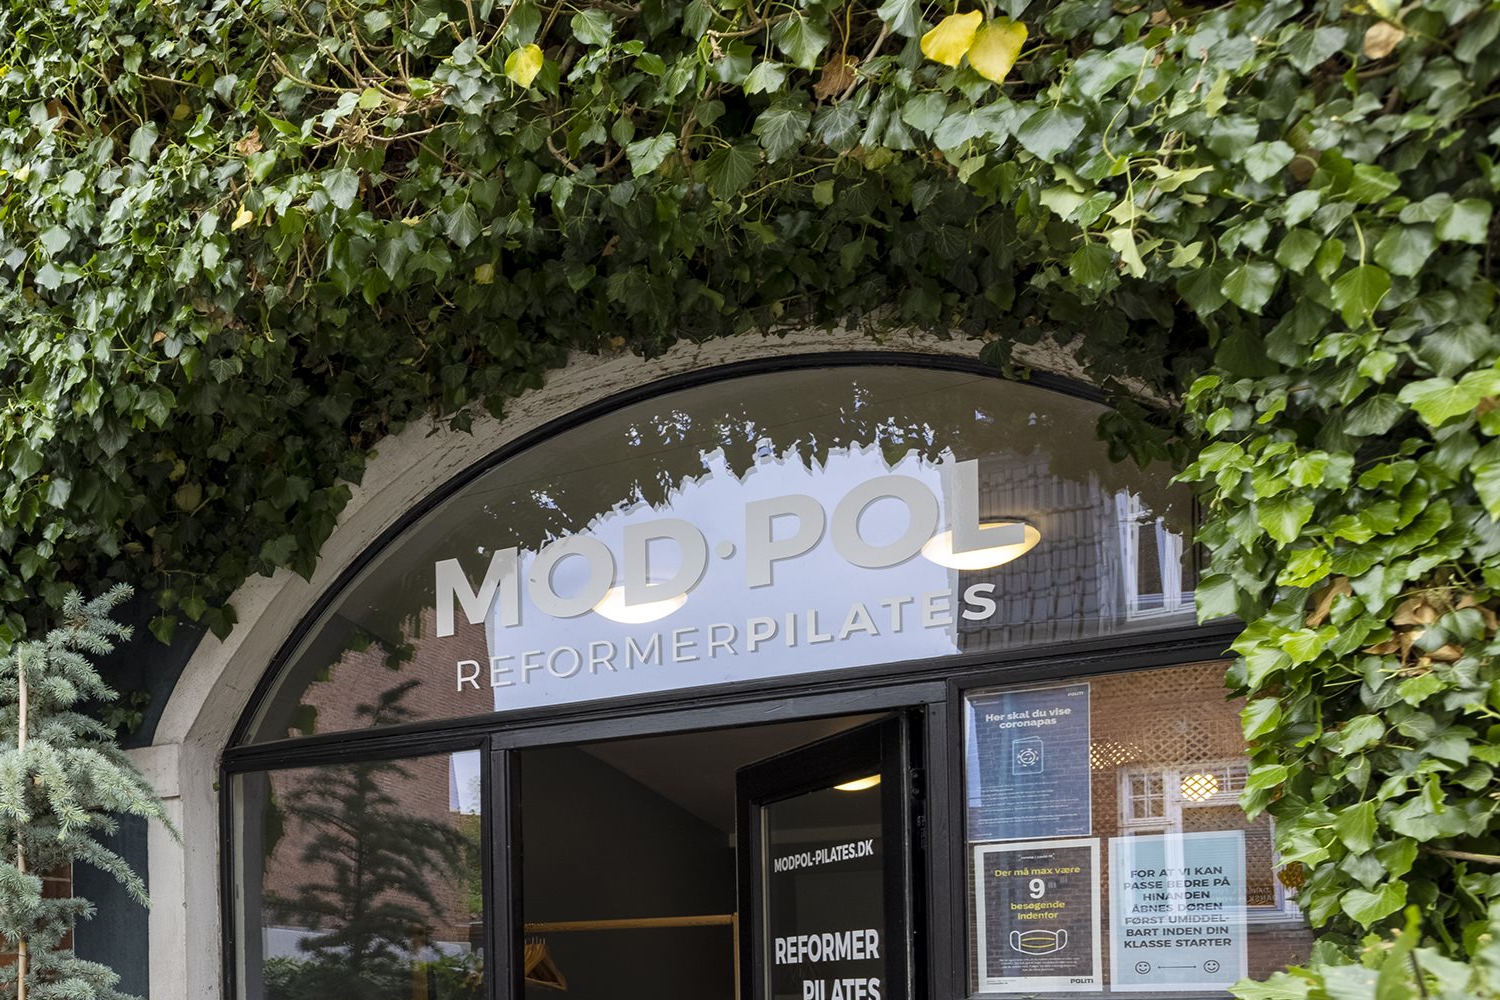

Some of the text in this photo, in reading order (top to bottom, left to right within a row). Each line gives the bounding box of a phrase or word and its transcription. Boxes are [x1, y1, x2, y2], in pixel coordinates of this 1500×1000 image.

[456, 582, 998, 692] REFORMERPILATES
[985, 707, 1072, 722] Her skal du vise
[999, 717, 1057, 729] coronapas
[774, 839, 874, 873] MODPOL-PILATES.DK
[995, 866, 1081, 877] Der må max være
[1131, 866, 1222, 878] FOR AT VI KAN
[1029, 878, 1045, 899] 9
[1124, 876, 1231, 890] PASSE BEDRE PÅ
[1143, 891, 1210, 901] HINANDEN
[1132, 902, 1222, 913] ÅBNES DØREN
[1125, 914, 1231, 925] FØRST UMIDDEL-
[1126, 926, 1229, 937] BART INDEN DIN
[775, 929, 880, 965] REFORMER
[1124, 938, 1232, 949] KLASSE STARTER
